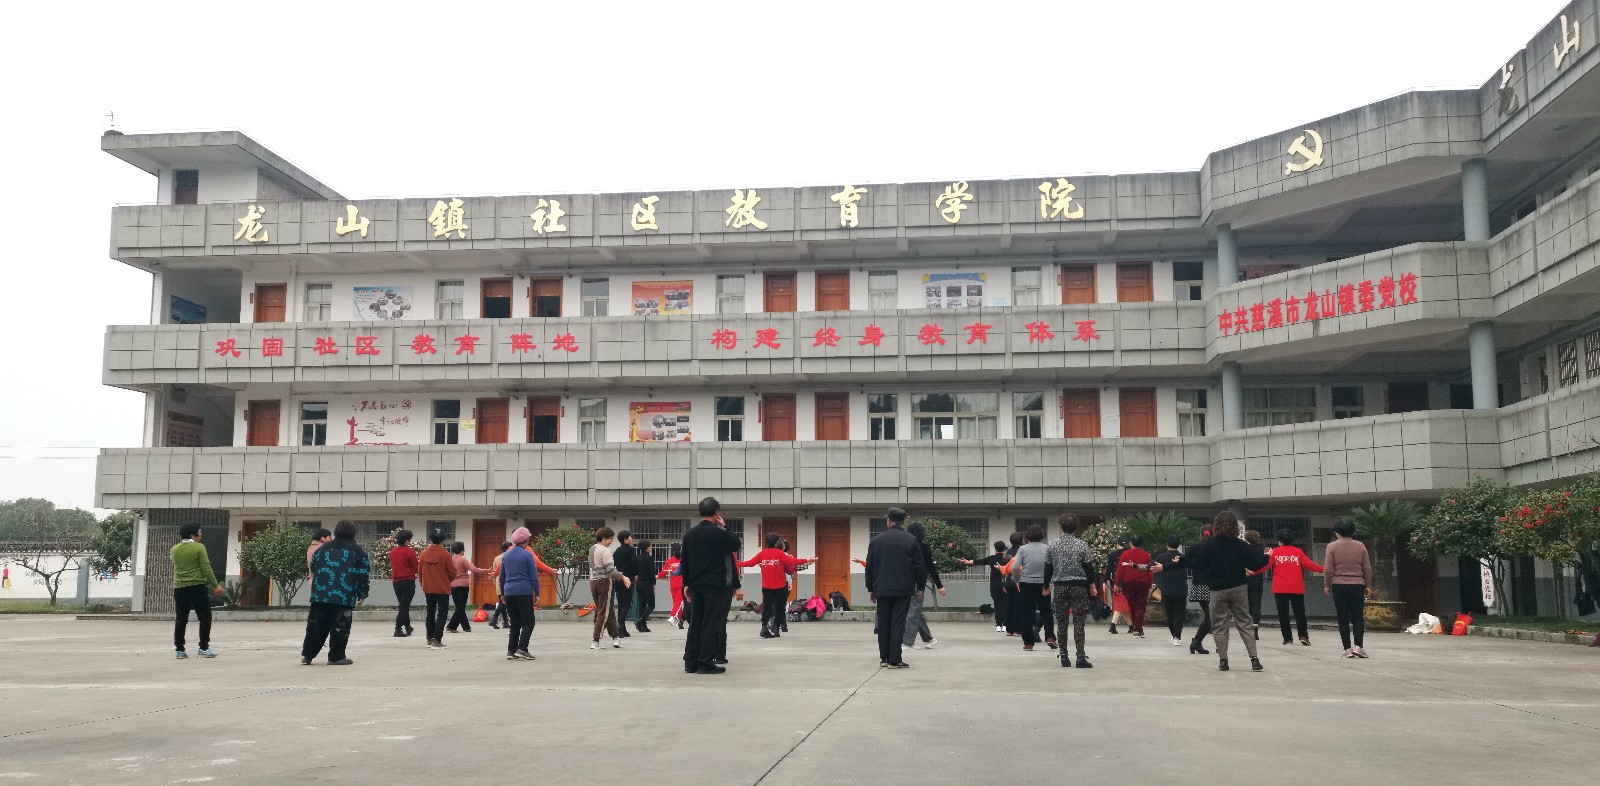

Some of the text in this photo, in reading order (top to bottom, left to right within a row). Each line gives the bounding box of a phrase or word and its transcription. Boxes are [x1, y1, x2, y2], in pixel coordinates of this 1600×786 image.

[1219, 272, 1418, 337] 中共慈溪市龙山镇委党校
